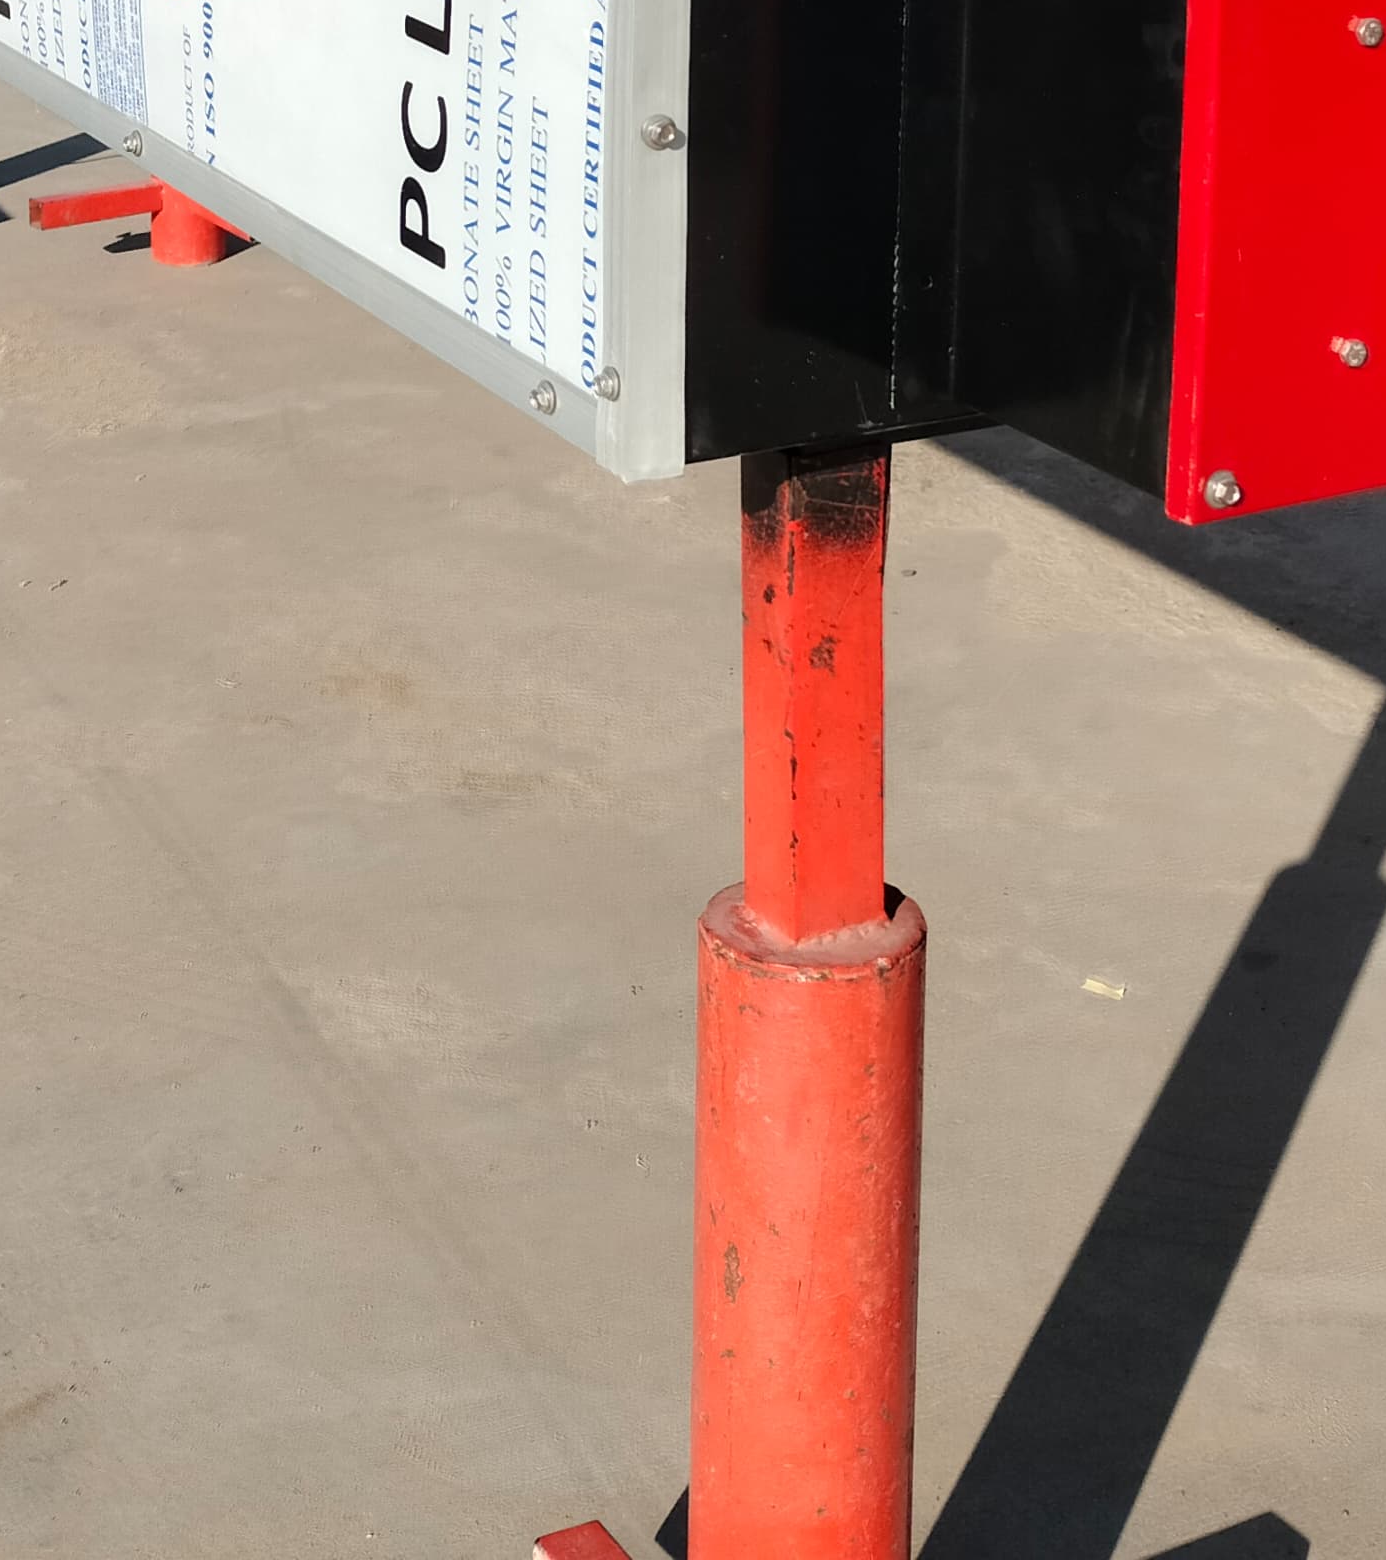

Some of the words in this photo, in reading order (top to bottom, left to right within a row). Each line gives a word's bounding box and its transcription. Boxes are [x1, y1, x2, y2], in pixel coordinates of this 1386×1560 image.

[202, 71, 216, 139] ISO
[463, 12, 486, 152] SHEET
[581, 19, 608, 241] CERTIFIED
[398, 79, 448, 270] PC
[493, 86, 517, 237] VIRGIN
[529, 94, 550, 239] SHEET
[580, 247, 600, 389] ODUCT
